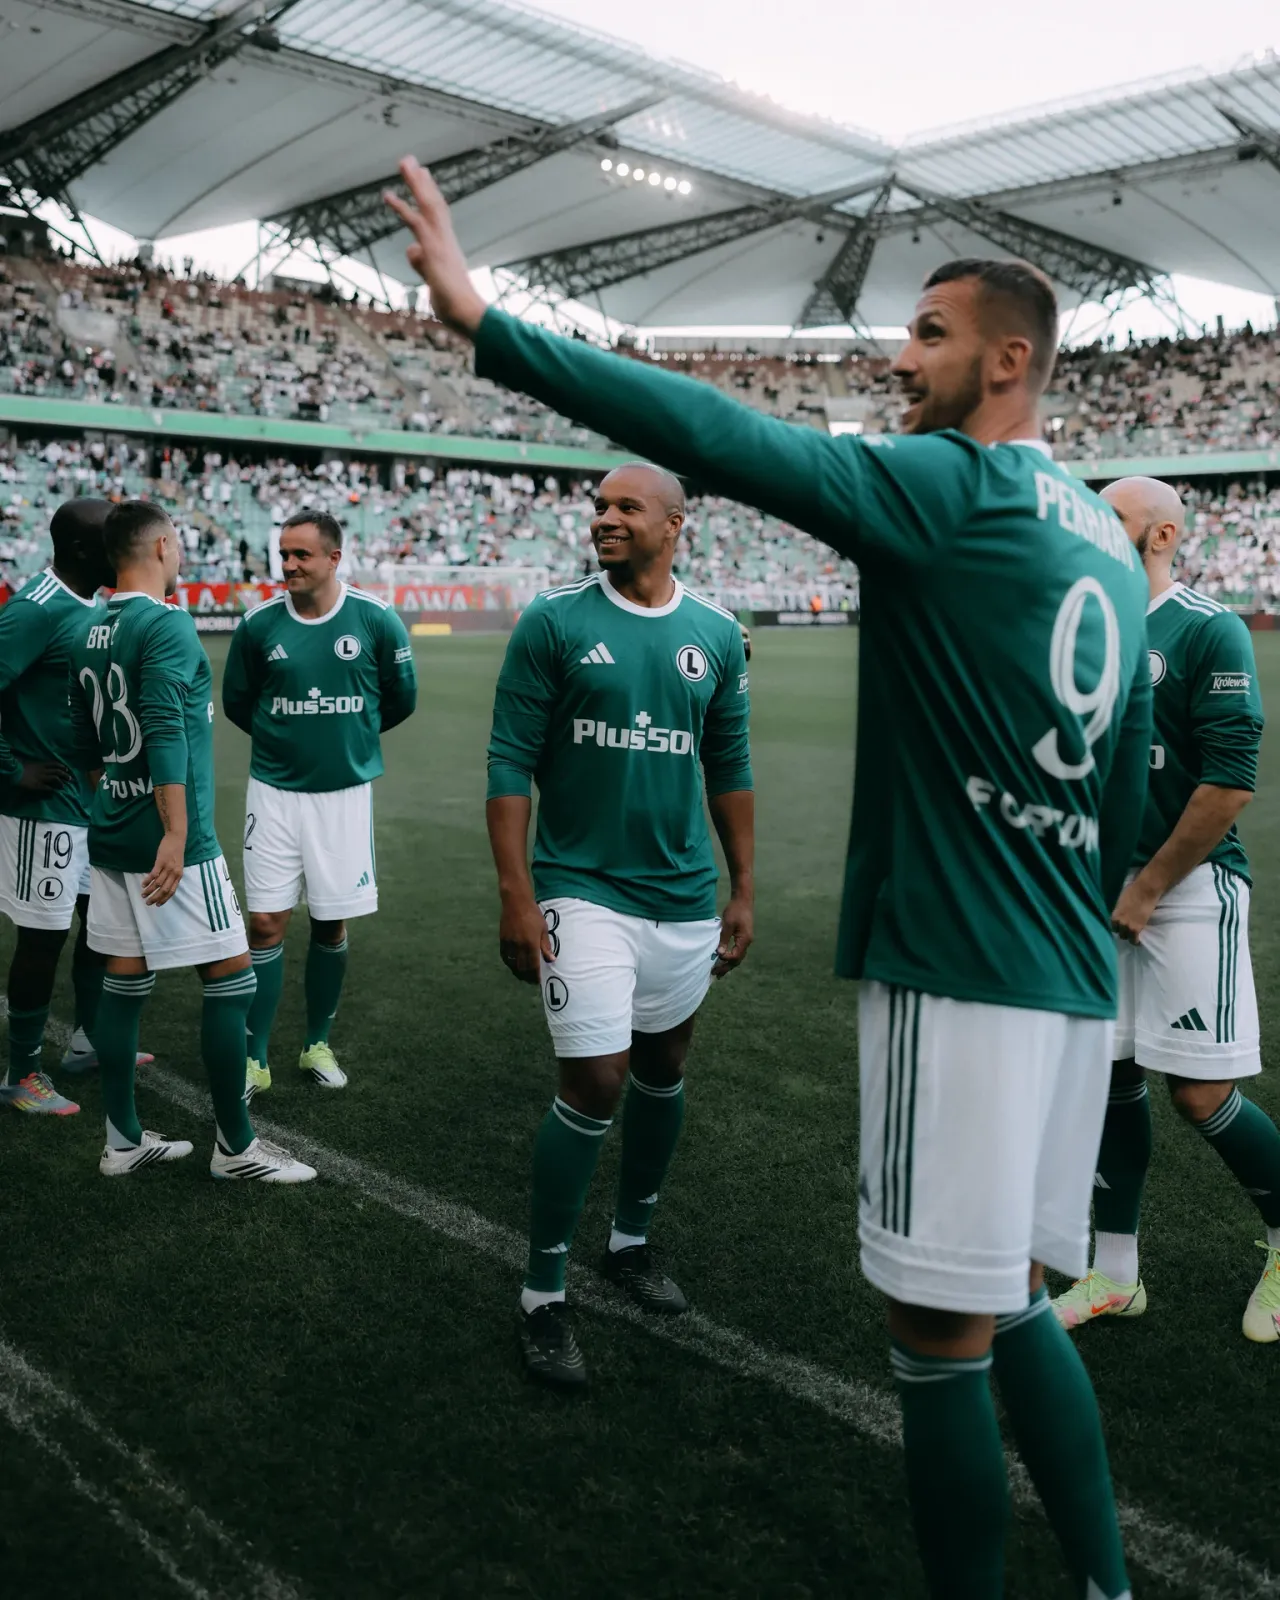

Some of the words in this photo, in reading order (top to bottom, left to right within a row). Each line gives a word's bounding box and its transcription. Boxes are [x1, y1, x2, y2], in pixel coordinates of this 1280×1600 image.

[1032, 576, 1120, 780] 9
[270, 694, 364, 715] Plus500
[573, 717, 695, 756] Plus50
[43, 830, 73, 870] 19
